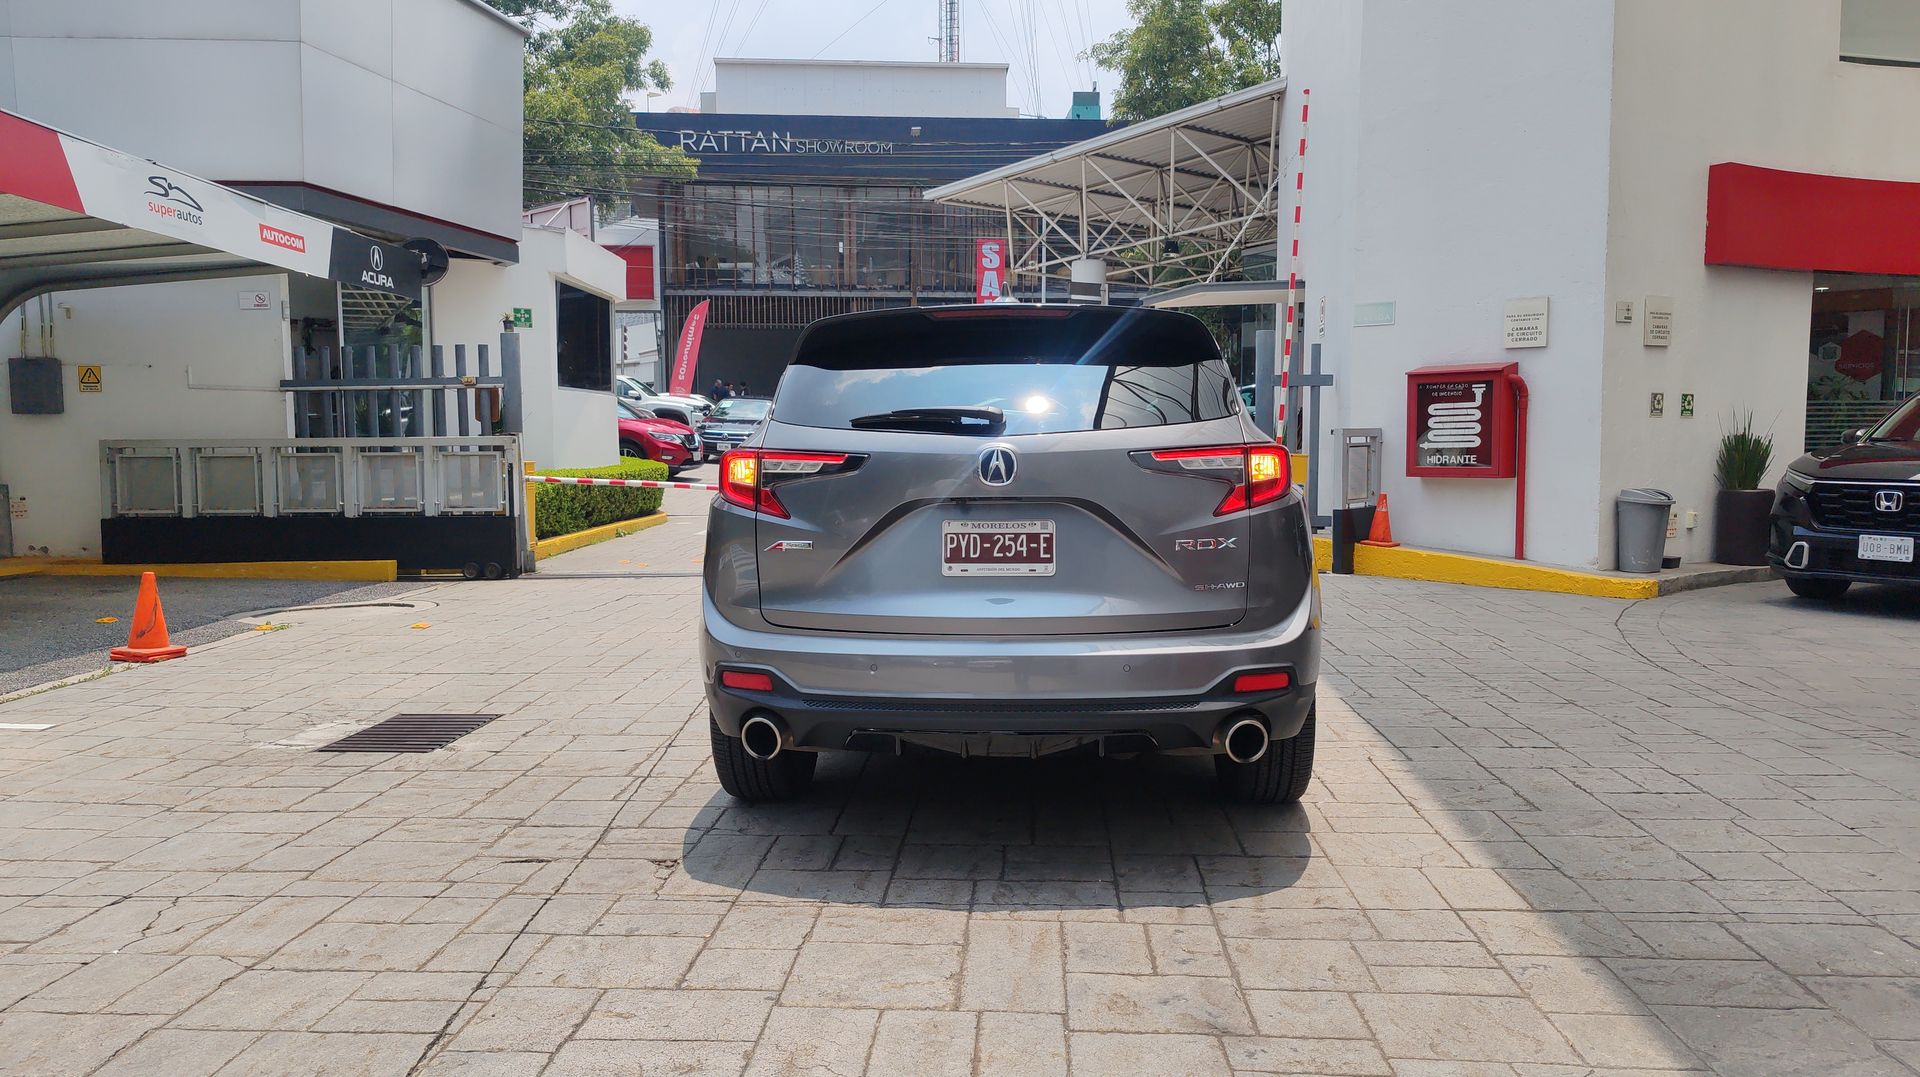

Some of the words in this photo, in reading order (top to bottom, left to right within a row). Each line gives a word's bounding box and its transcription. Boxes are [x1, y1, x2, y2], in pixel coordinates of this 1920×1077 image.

[680, 130, 791, 153] RATTAN
[795, 139, 893, 155] SHOWROOM
[148, 201, 203, 226] superautos
[262, 228, 304, 249] AUTOCOM
[361, 270, 395, 289] ACURA
[981, 242, 1000, 304] SA
[1426, 455, 1477, 464] HIDRANTE
[971, 522, 1027, 530] MORELOS
[946, 534, 1051, 558] PYD-254-E
[1175, 537, 1238, 551] RDX
[1194, 581, 1245, 591] SH-AWD
